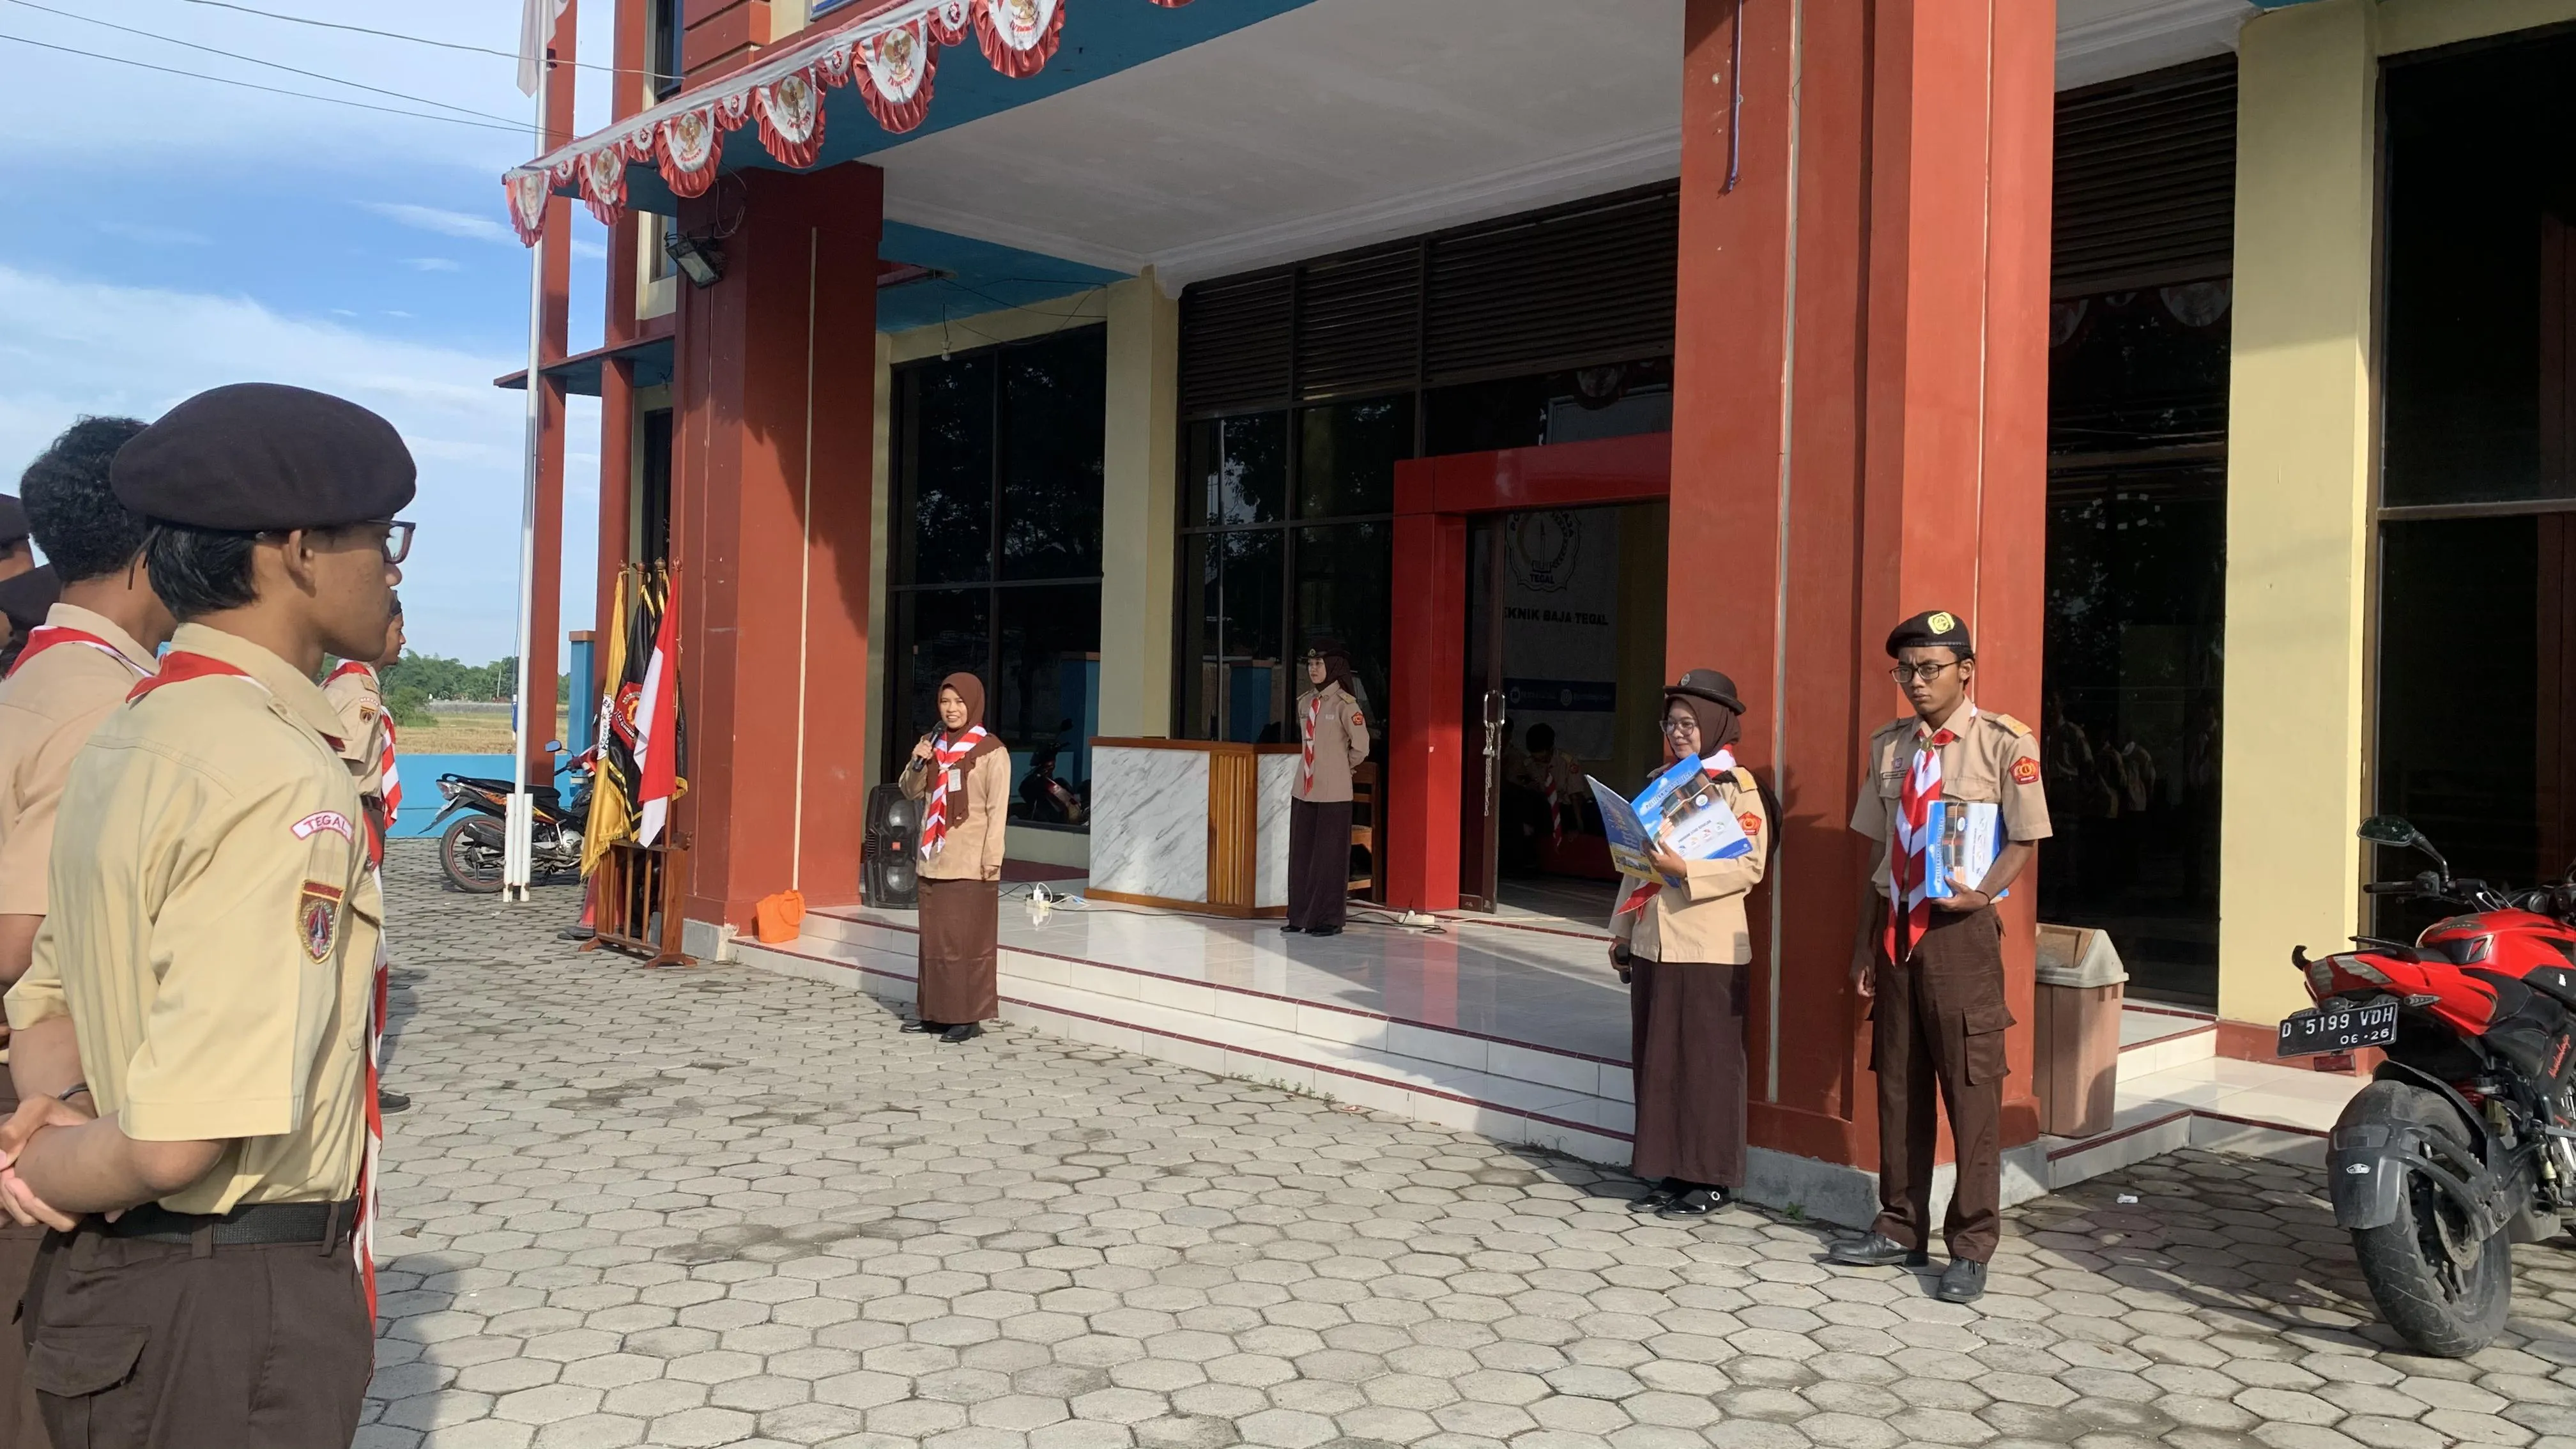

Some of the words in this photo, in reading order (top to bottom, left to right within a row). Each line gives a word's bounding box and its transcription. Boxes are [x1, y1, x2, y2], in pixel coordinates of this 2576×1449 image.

[1529, 574, 1555, 584] TEGAL
[1543, 610, 1572, 624] BAJA
[1575, 612, 1608, 625] TEGAL
[303, 815, 348, 834] TEGAL
[2282, 1022, 2292, 1038] D
[2305, 1013, 2350, 1035] 5199
[2360, 1006, 2394, 1027] VDH
